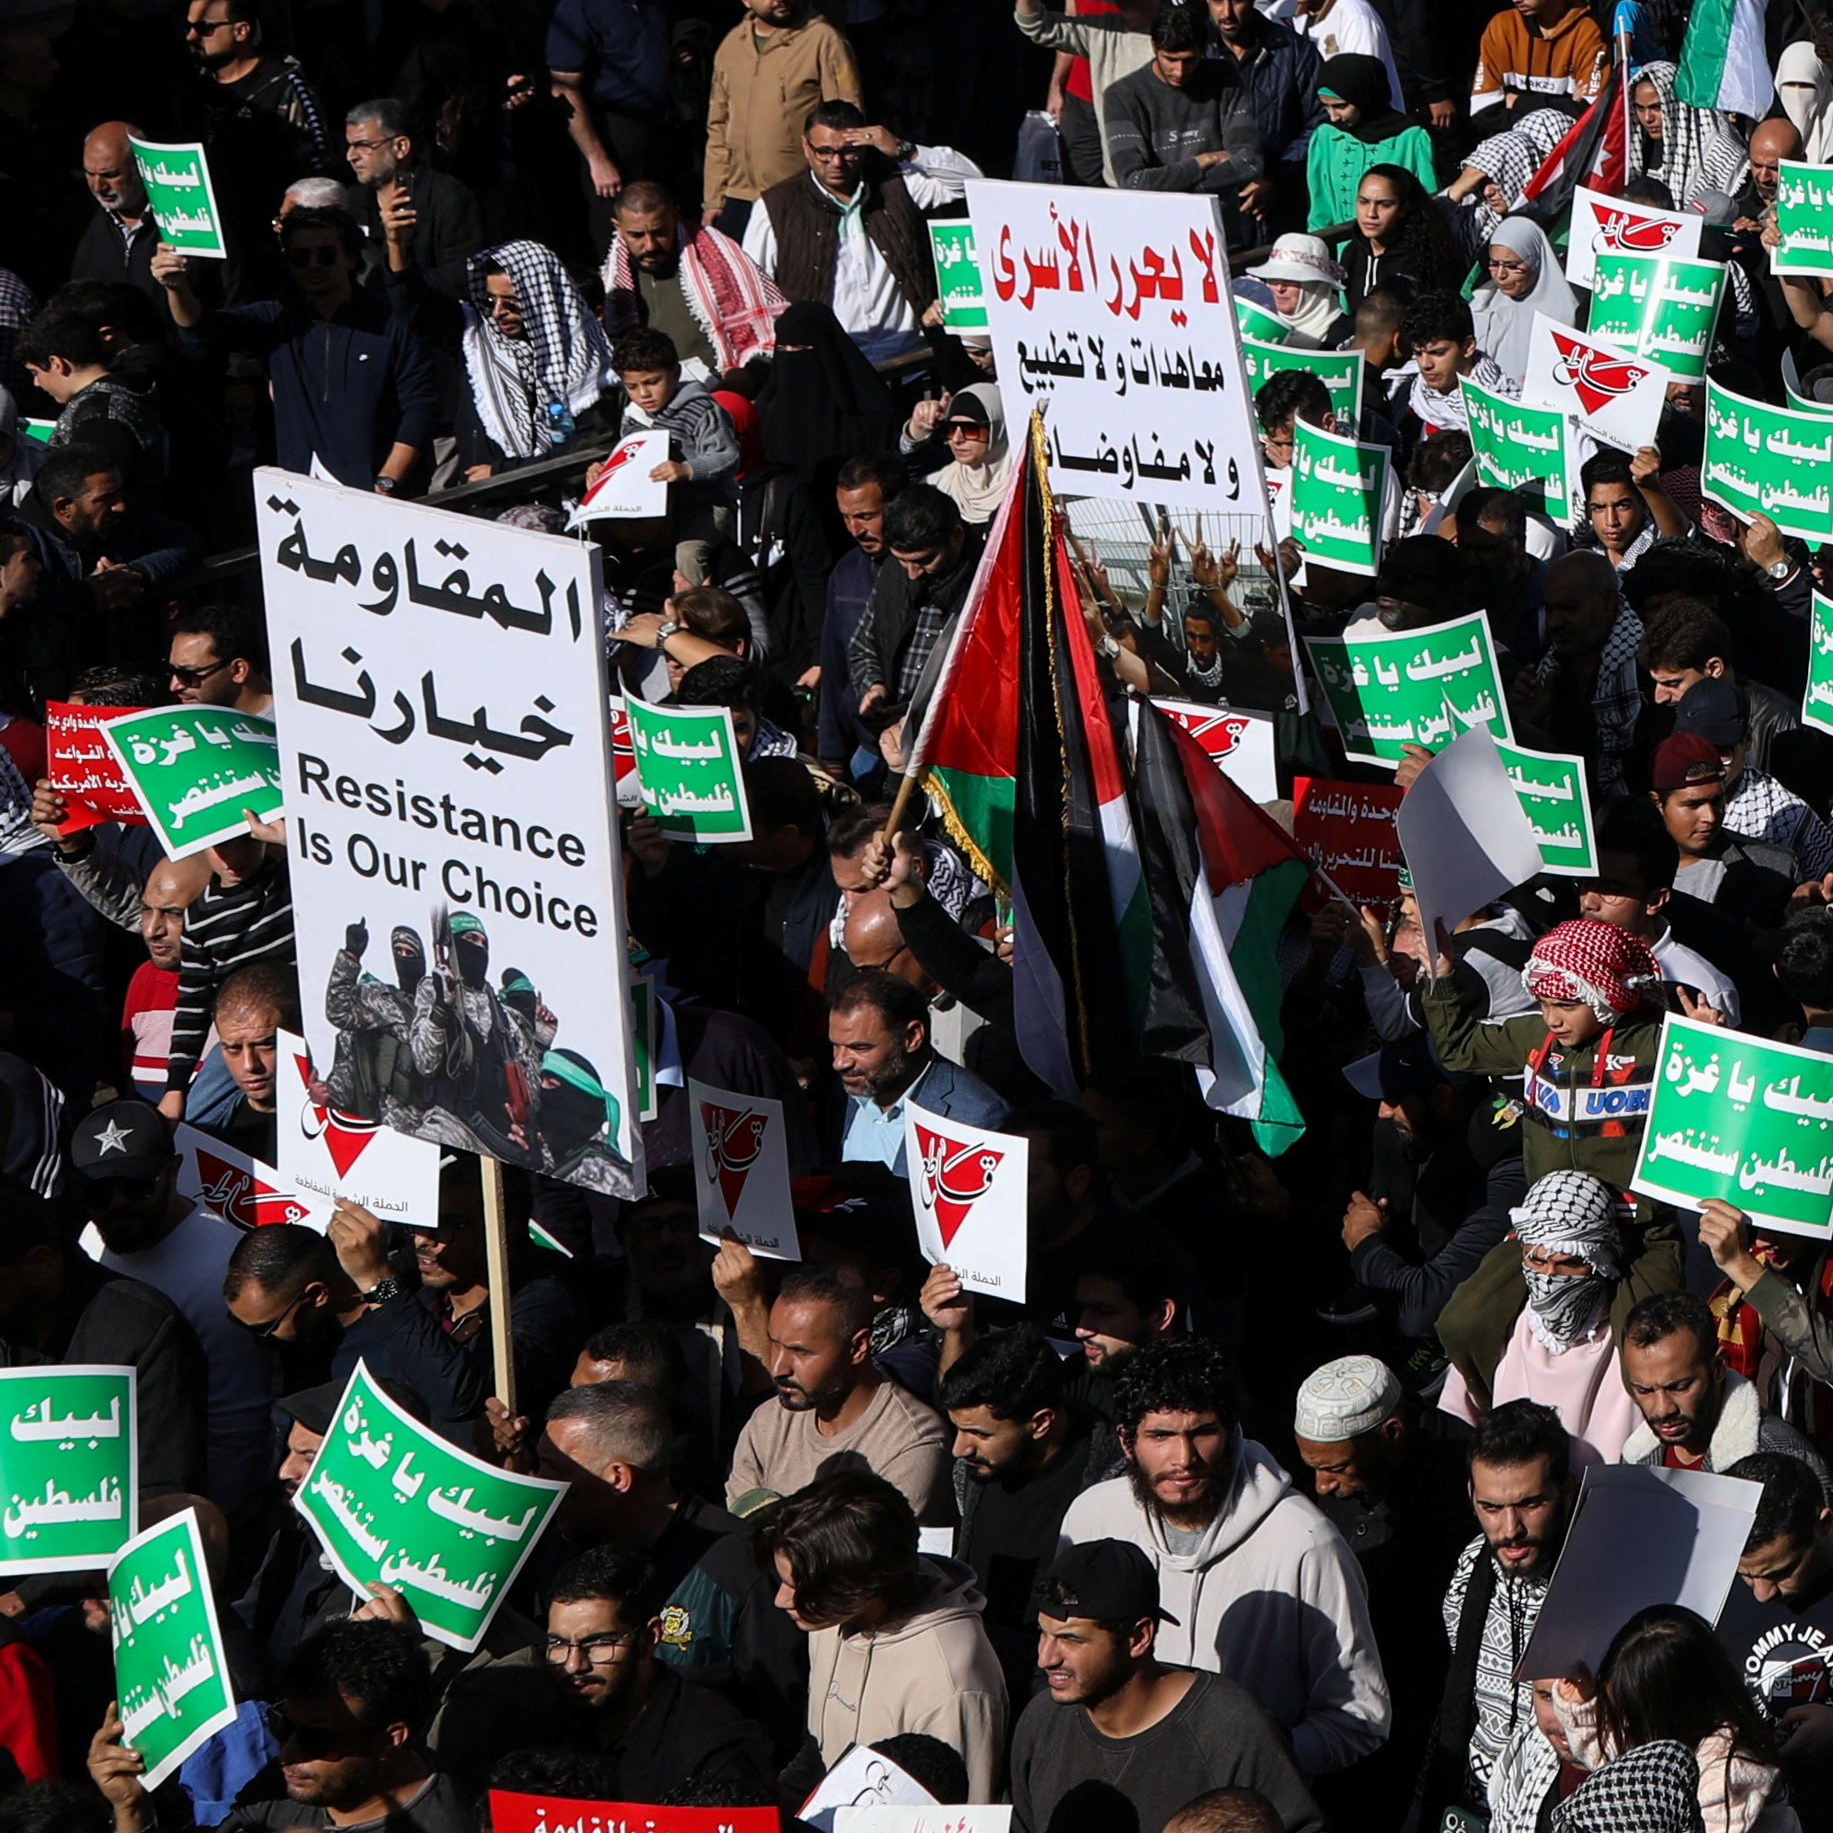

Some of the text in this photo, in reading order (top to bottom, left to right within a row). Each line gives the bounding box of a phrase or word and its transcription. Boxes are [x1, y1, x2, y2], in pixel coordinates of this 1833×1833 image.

[991, 200, 1220, 327] لا يحرر الأسرى
[1017, 329, 1225, 397] معاهدات و لا تطبيع
[1048, 424, 1240, 501] و لا مفاوضا
[266, 493, 583, 644] المقاومة
[290, 636, 576, 777] خيارنا
[297, 750, 587, 868] Resistance
[298, 817, 601, 939] Is Our Choice
[1663, 1041, 1721, 1096] غزة
[1729, 1063, 1757, 1112] يا
[1646, 1127, 1739, 1178] ستنتصر
[342, 1393, 539, 1547] لبيك يا غزة
[310, 1467, 495, 1612] فلسطين ستنتصر
[1744, 1622, 1797, 1687] TOMMY
